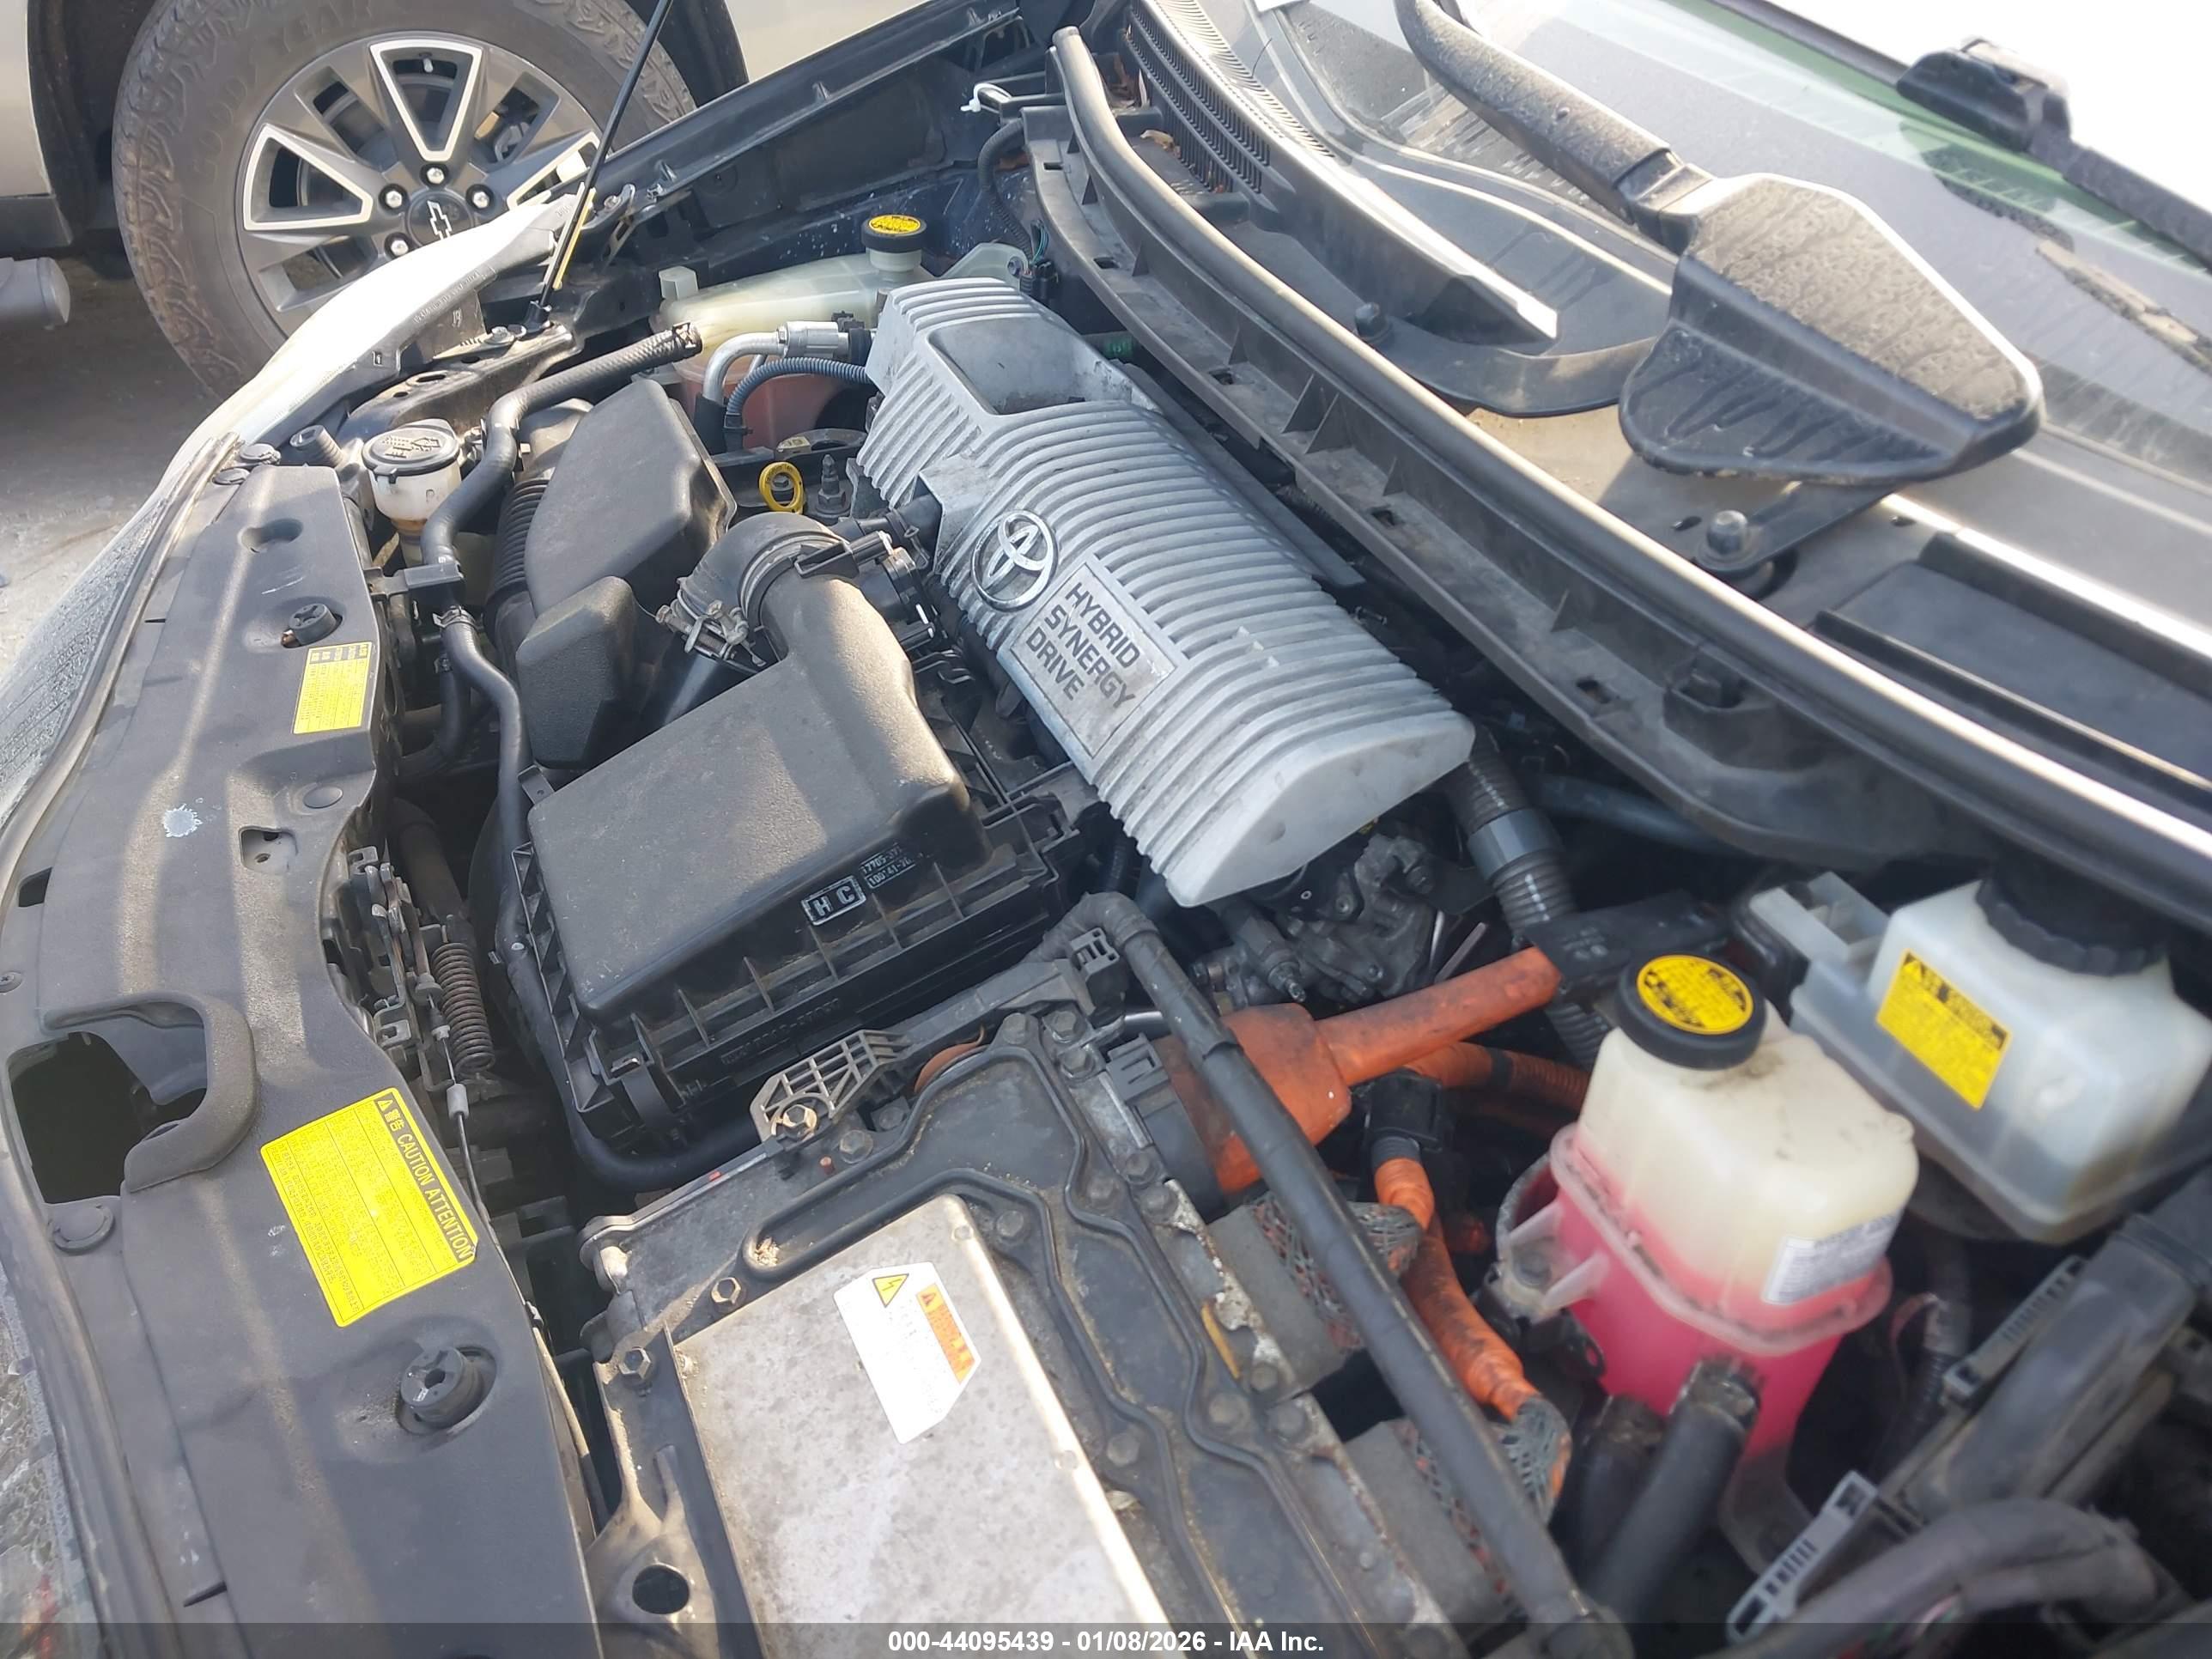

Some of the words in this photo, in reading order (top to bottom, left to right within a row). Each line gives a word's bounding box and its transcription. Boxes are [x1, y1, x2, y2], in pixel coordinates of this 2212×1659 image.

[1025, 626, 1085, 701] DRIVE
[1044, 604, 1136, 708] SYNERGY
[1065, 582, 1140, 669] HYBRID
[384, 1109, 405, 1132] 警告
[397, 1133, 435, 1186] CAUTION
[424, 1187, 474, 1260] ATTENTION
